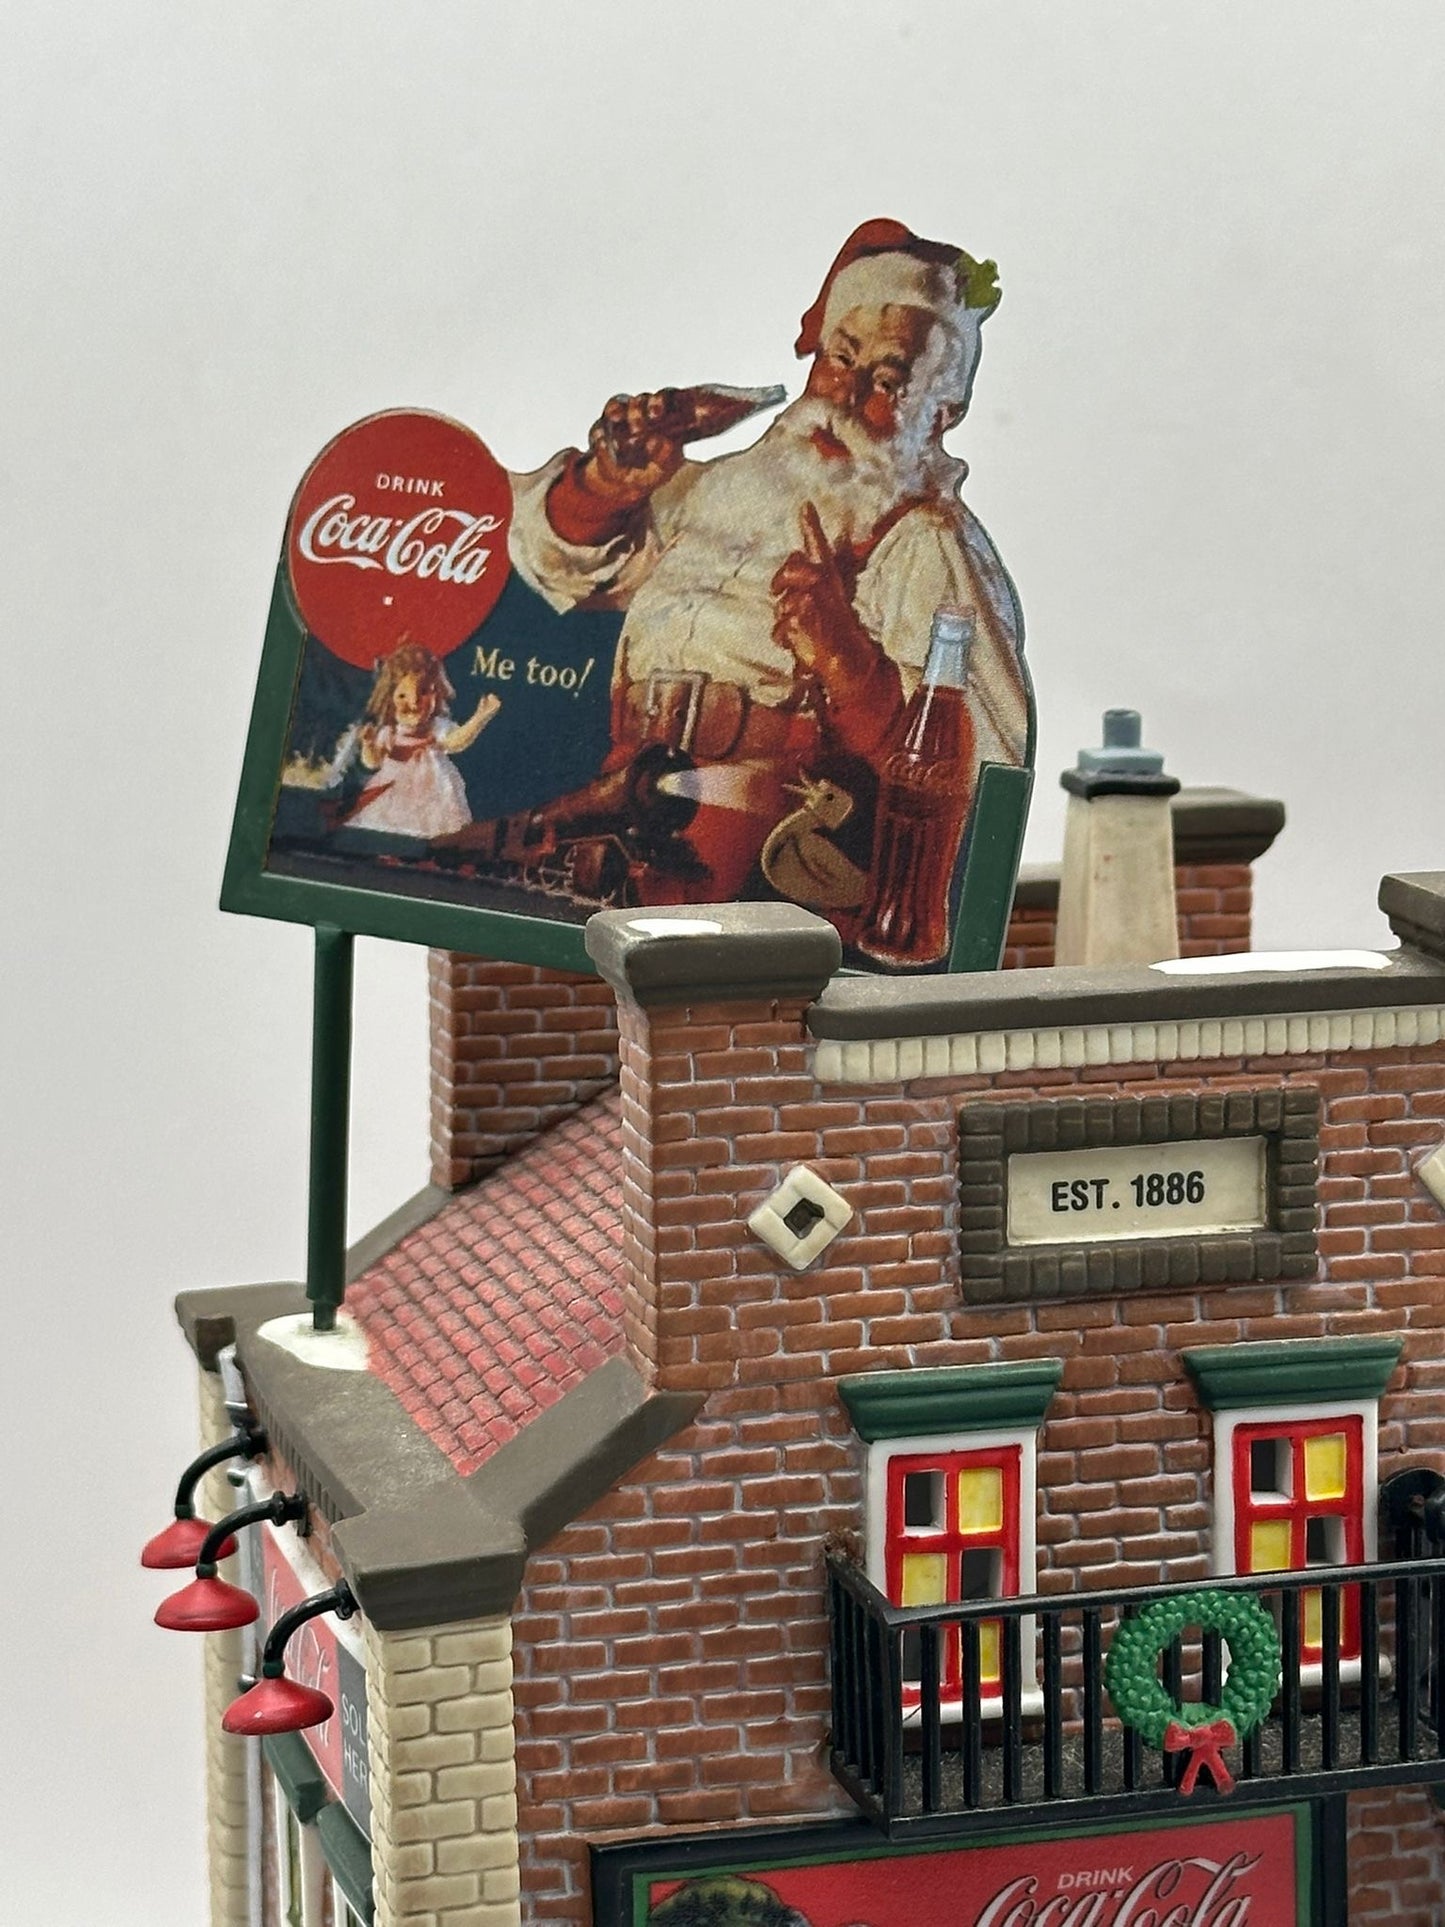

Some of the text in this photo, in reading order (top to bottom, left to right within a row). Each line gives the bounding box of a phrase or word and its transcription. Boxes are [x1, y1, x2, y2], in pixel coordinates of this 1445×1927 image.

[376, 473, 445, 497] DRINK
[299, 494, 504, 584] Coca-Cola
[471, 645, 595, 698] Me too!
[1052, 1171, 1205, 1212] EST. 1886
[341, 1692, 366, 1747] SOL
[343, 1737, 368, 1794] HER
[1057, 1866, 1134, 1890] DRINK
